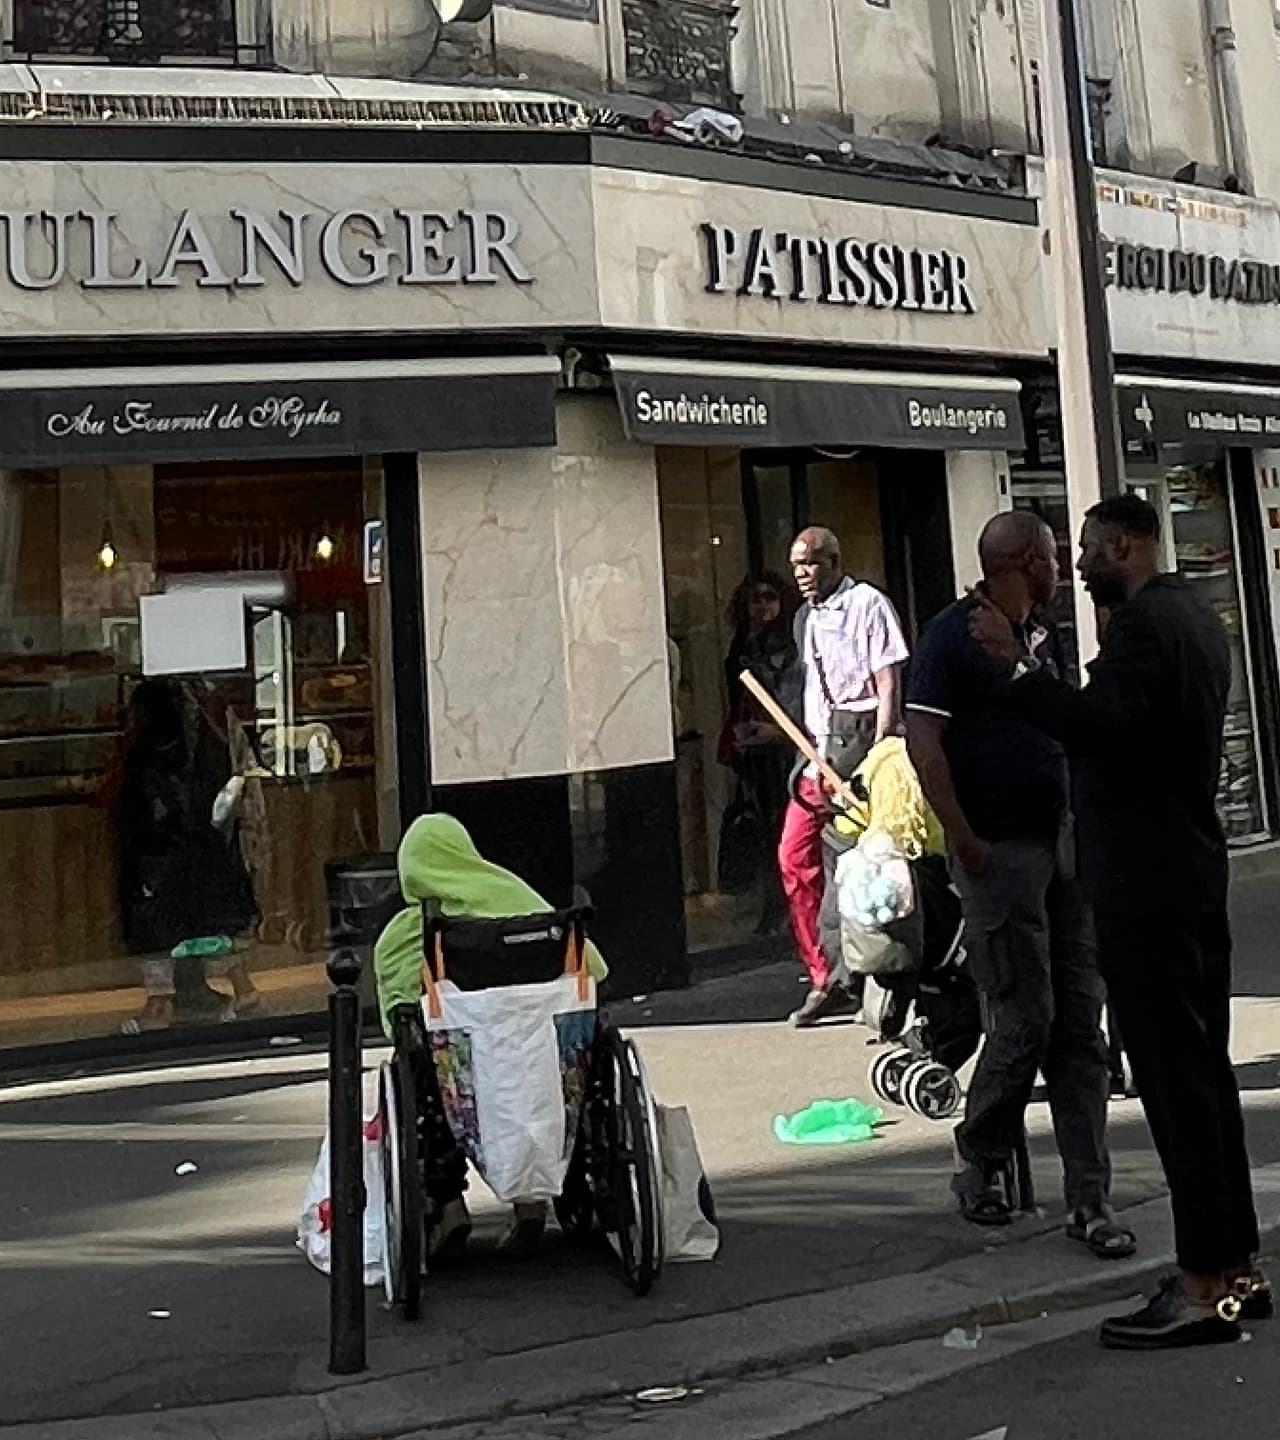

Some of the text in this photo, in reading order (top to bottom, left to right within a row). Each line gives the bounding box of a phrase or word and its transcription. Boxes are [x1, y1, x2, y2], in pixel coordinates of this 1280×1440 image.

[699, 223, 977, 314] PATISSIER
[1169, 248, 1207, 296] DU
[47, 403, 106, 437] Au
[217, 401, 244, 430] de
[635, 391, 1009, 434] Sandwicherie Boulangerie
